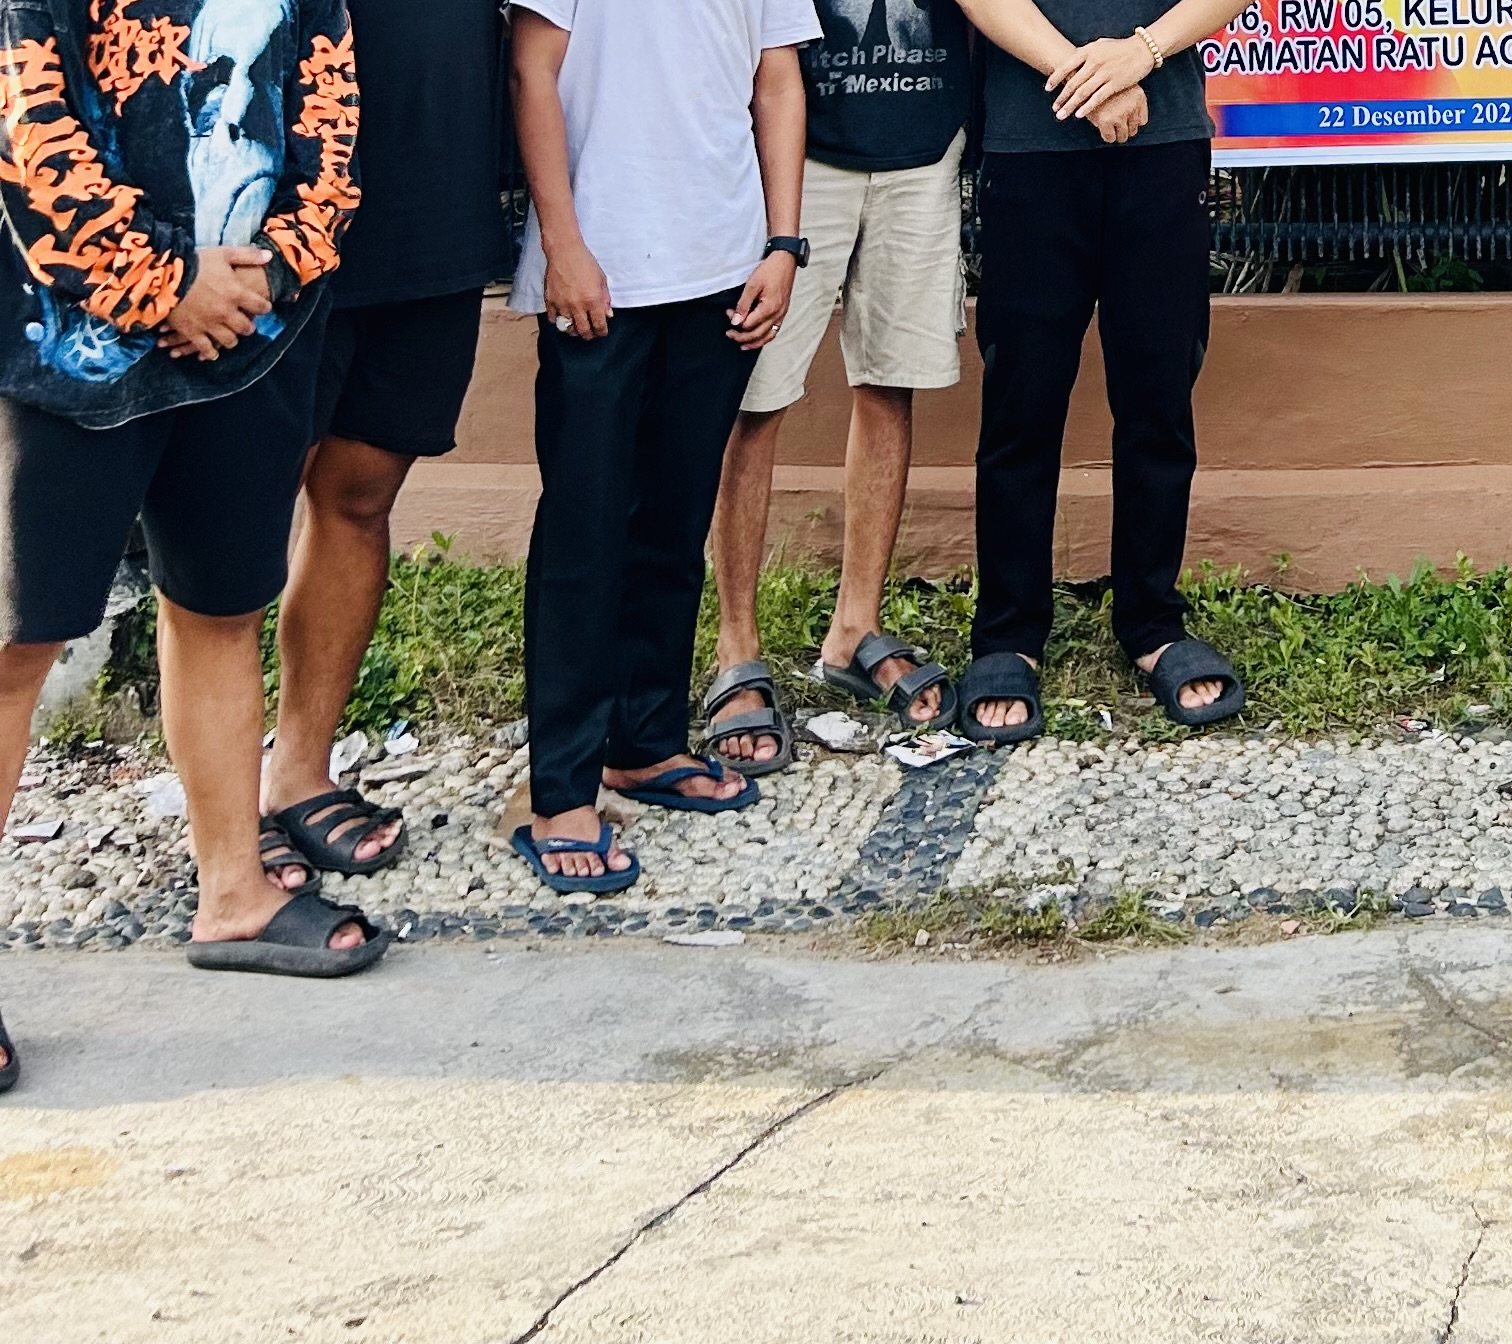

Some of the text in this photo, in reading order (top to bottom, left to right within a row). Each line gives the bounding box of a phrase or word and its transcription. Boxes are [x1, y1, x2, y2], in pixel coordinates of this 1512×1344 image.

[872, 44, 948, 65] Please
[1199, 39, 1363, 74] CAMATAN
[1377, 35, 1463, 69] RATU
[1319, 107, 1345, 128] 22
[1352, 104, 1465, 127] Desember
